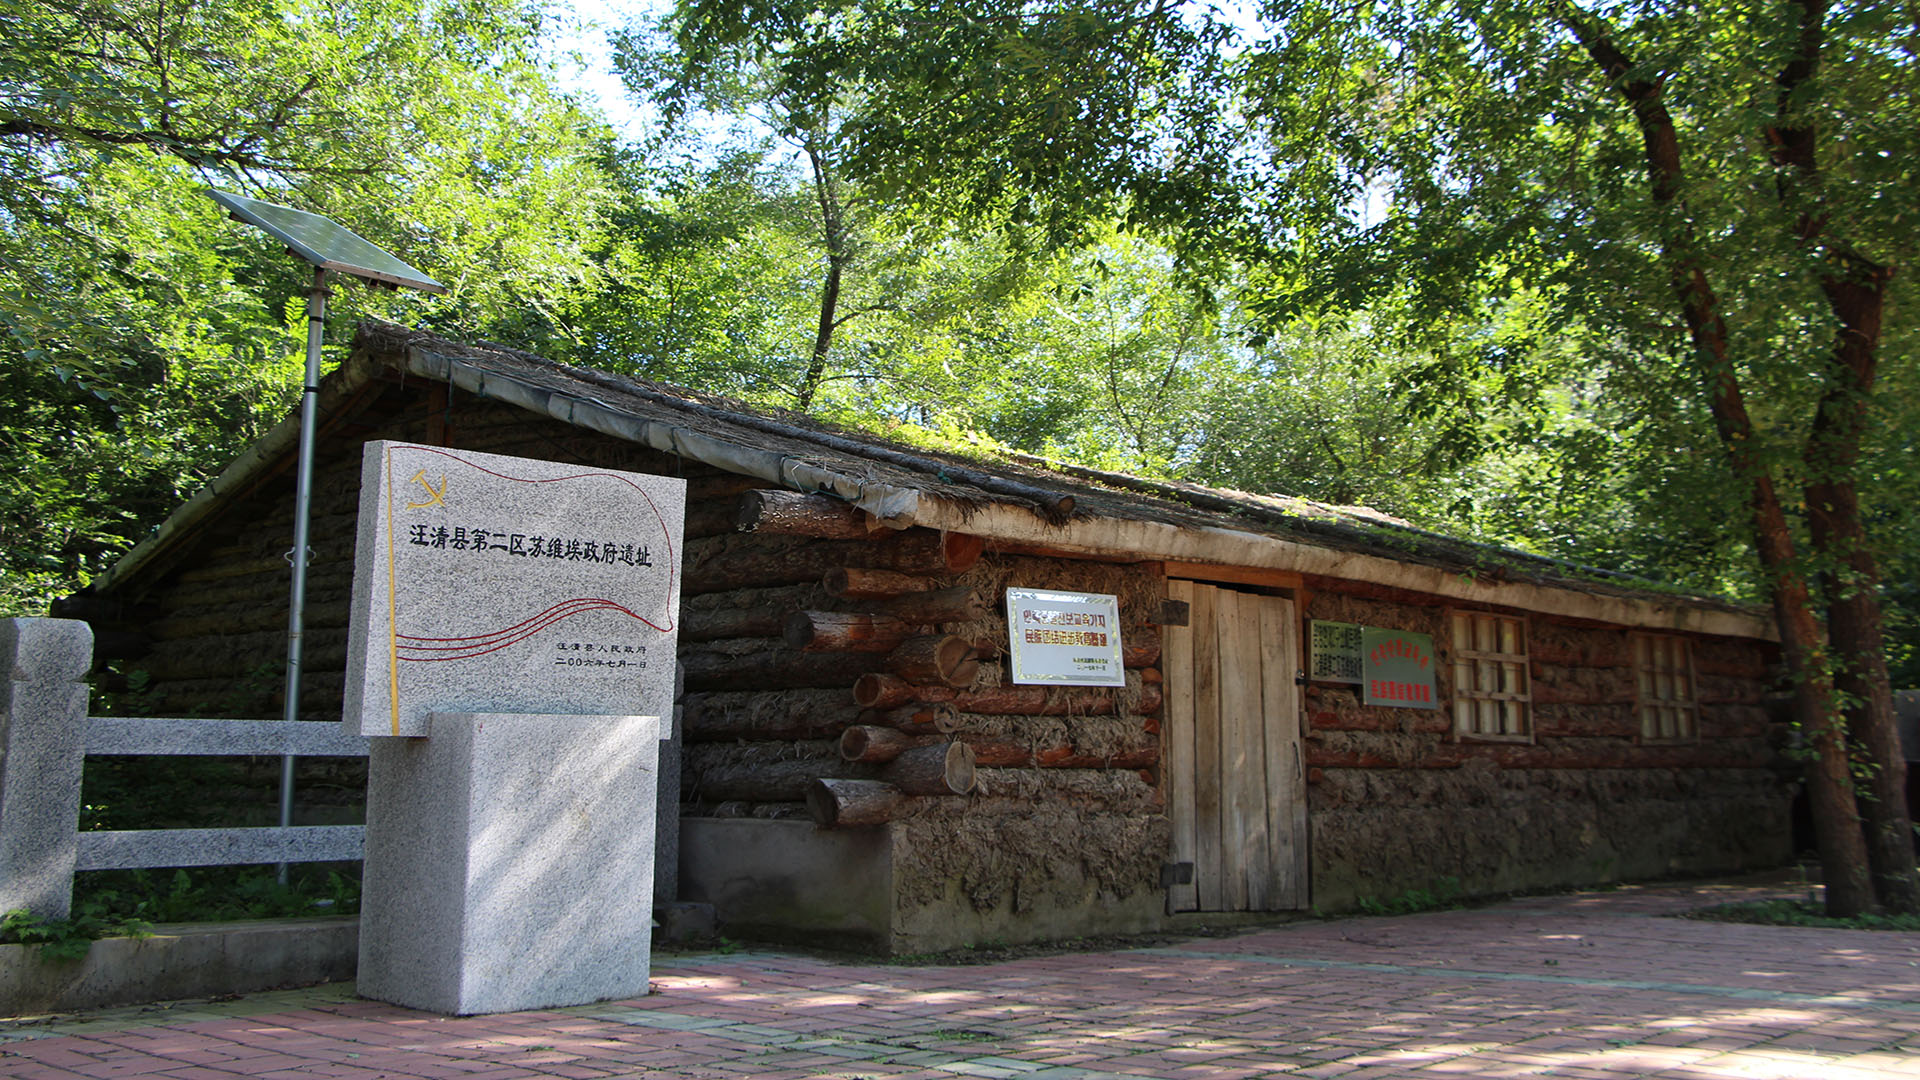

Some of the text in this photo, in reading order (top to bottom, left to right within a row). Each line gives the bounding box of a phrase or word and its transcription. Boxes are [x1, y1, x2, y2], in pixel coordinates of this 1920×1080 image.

[409, 524, 653, 567] 汪清县第二区苏维埃政府遗址
[556, 642, 647, 654] 汪清县人民政府
